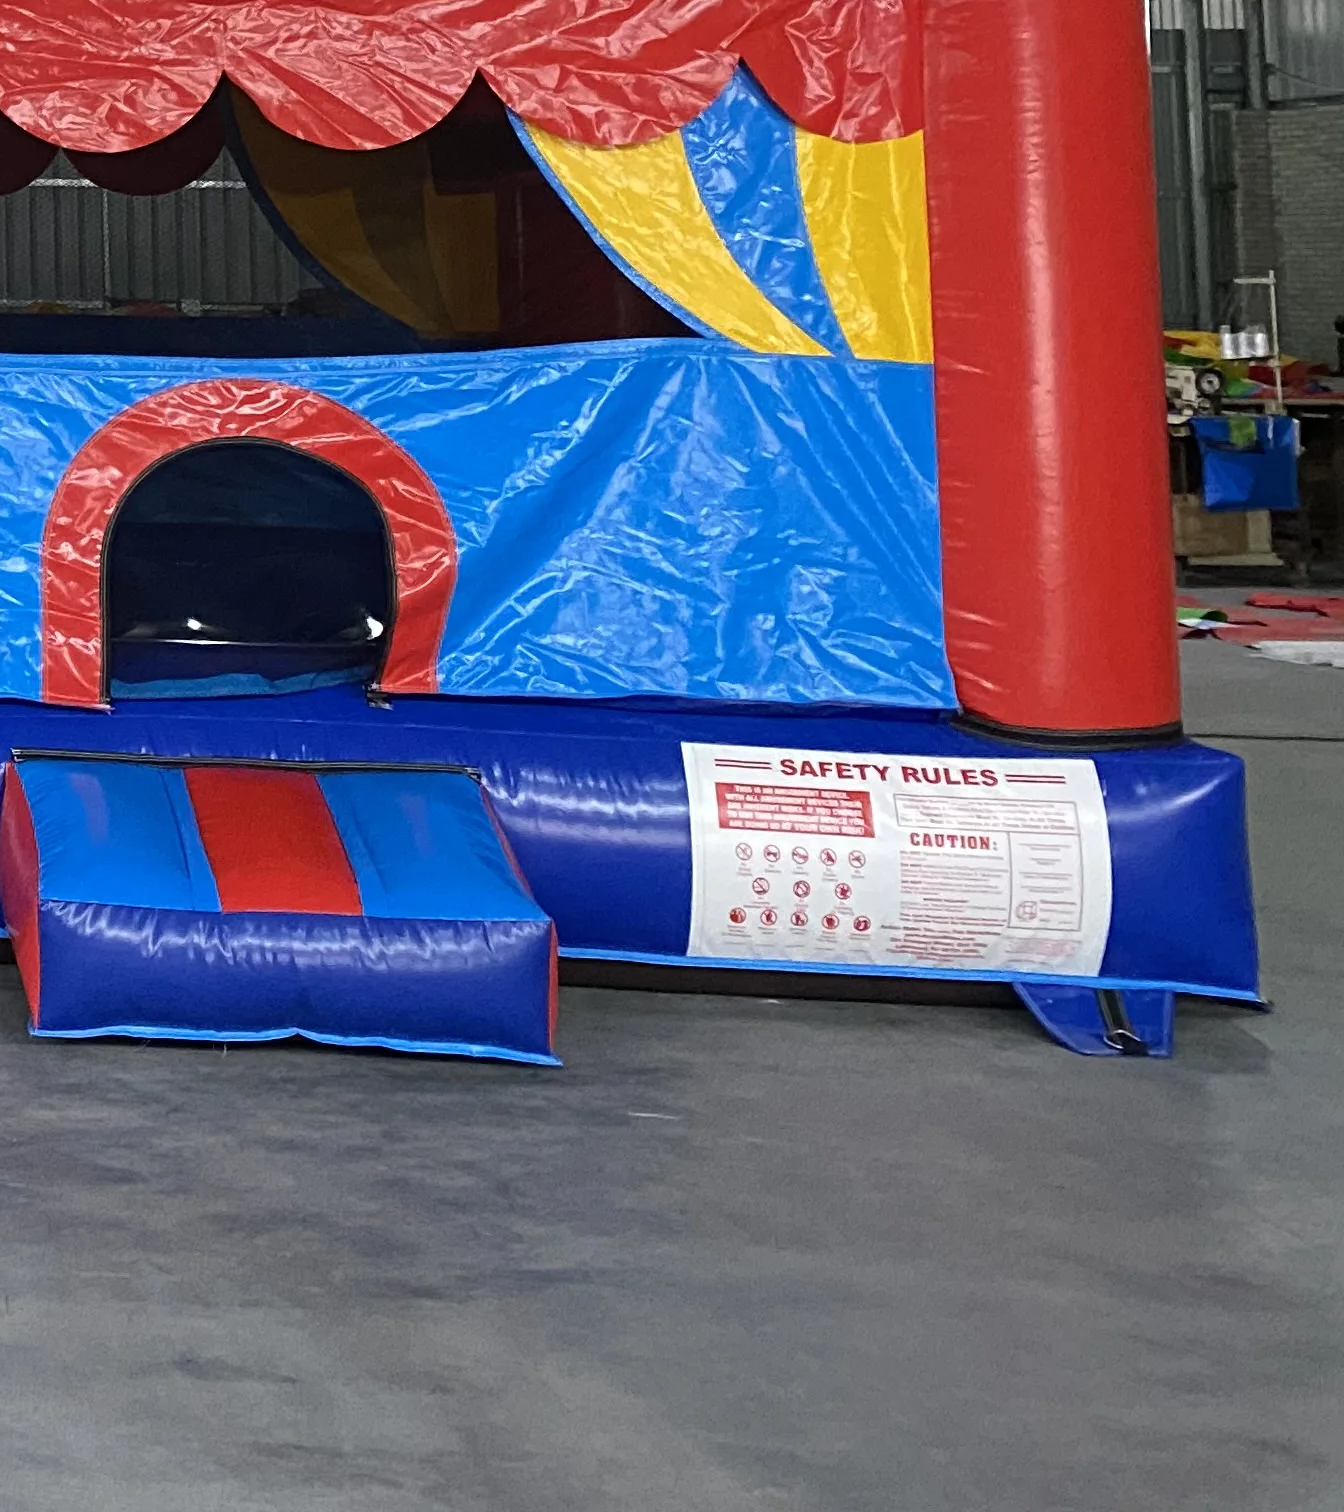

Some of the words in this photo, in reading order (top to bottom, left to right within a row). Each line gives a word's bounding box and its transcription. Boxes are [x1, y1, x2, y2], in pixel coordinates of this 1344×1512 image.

[780, 759, 889, 781] SAFETY
[902, 766, 999, 787] RULES
[909, 832, 998, 851] CAUTION:
